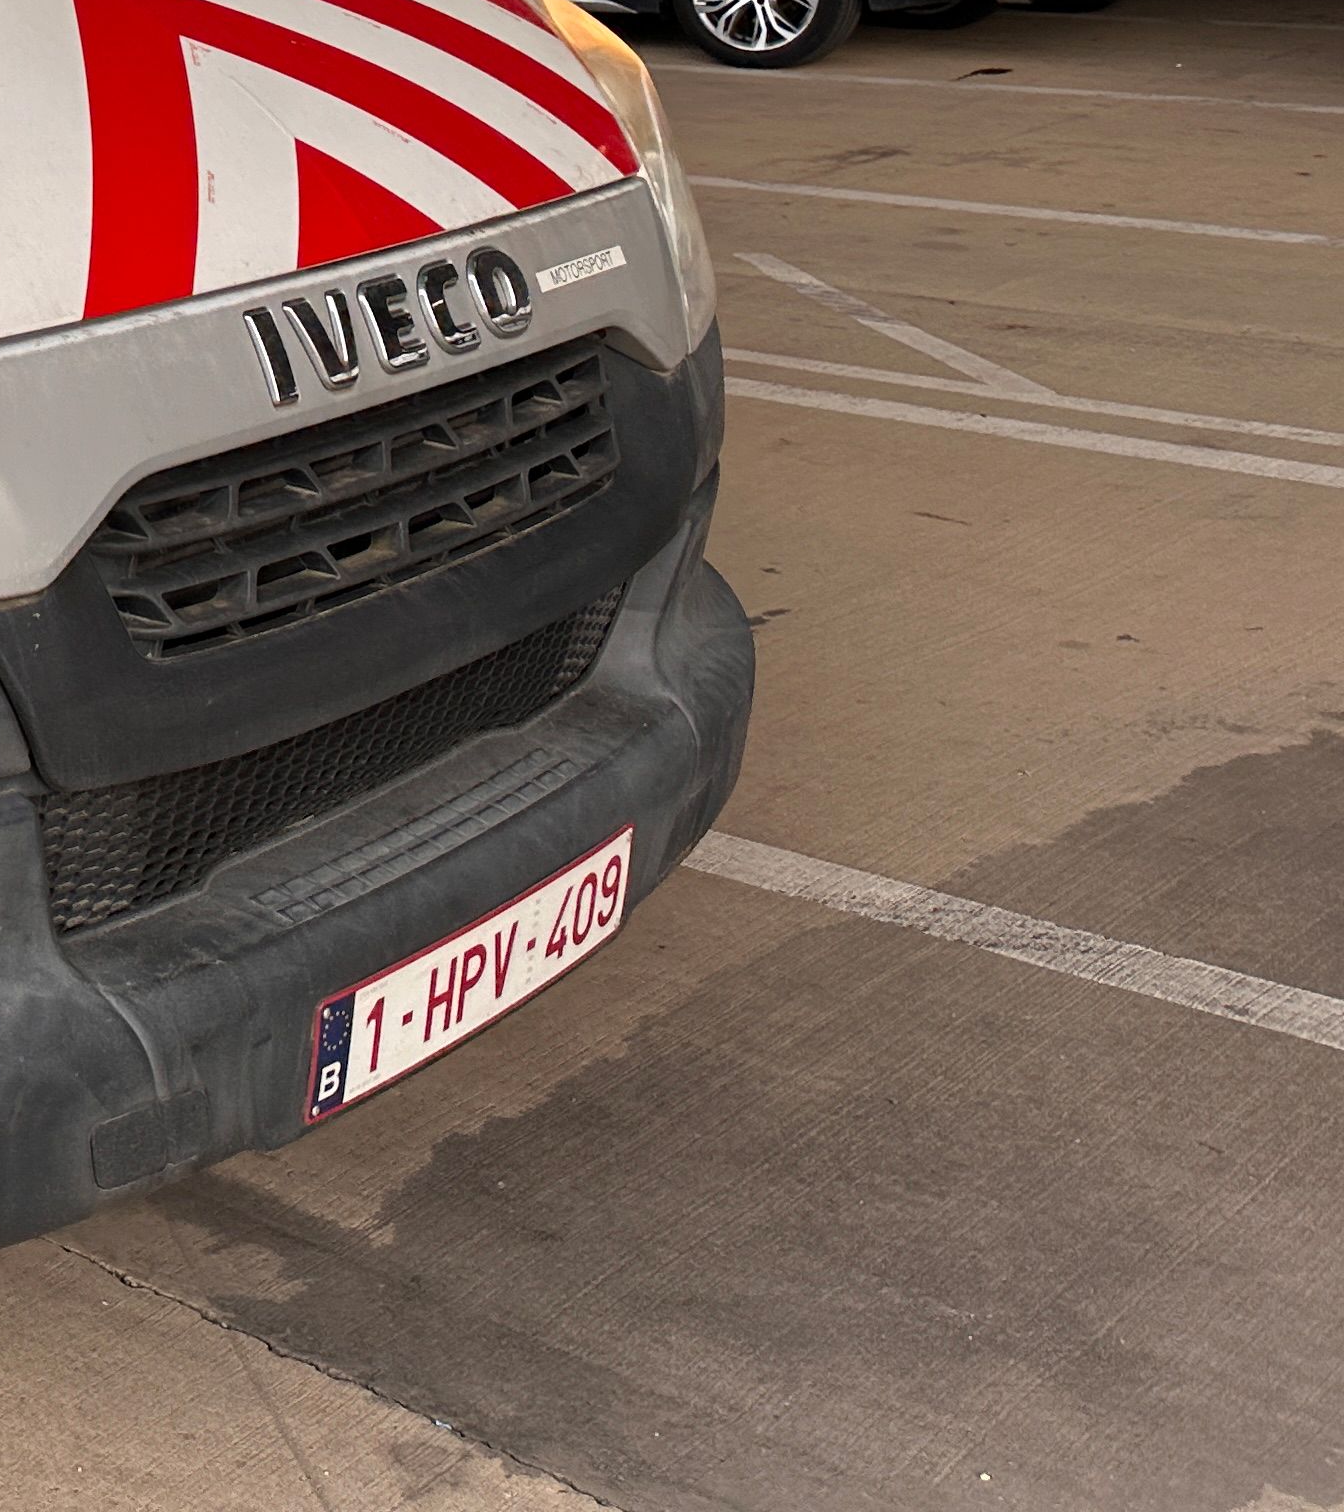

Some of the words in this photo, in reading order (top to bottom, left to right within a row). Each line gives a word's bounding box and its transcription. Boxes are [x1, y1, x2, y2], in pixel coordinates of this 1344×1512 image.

[550, 250, 614, 285] MOTORSPORT
[243, 245, 533, 407] IVECO
[365, 854, 623, 1074] 1-HPV-409
[317, 1061, 342, 1101] B
